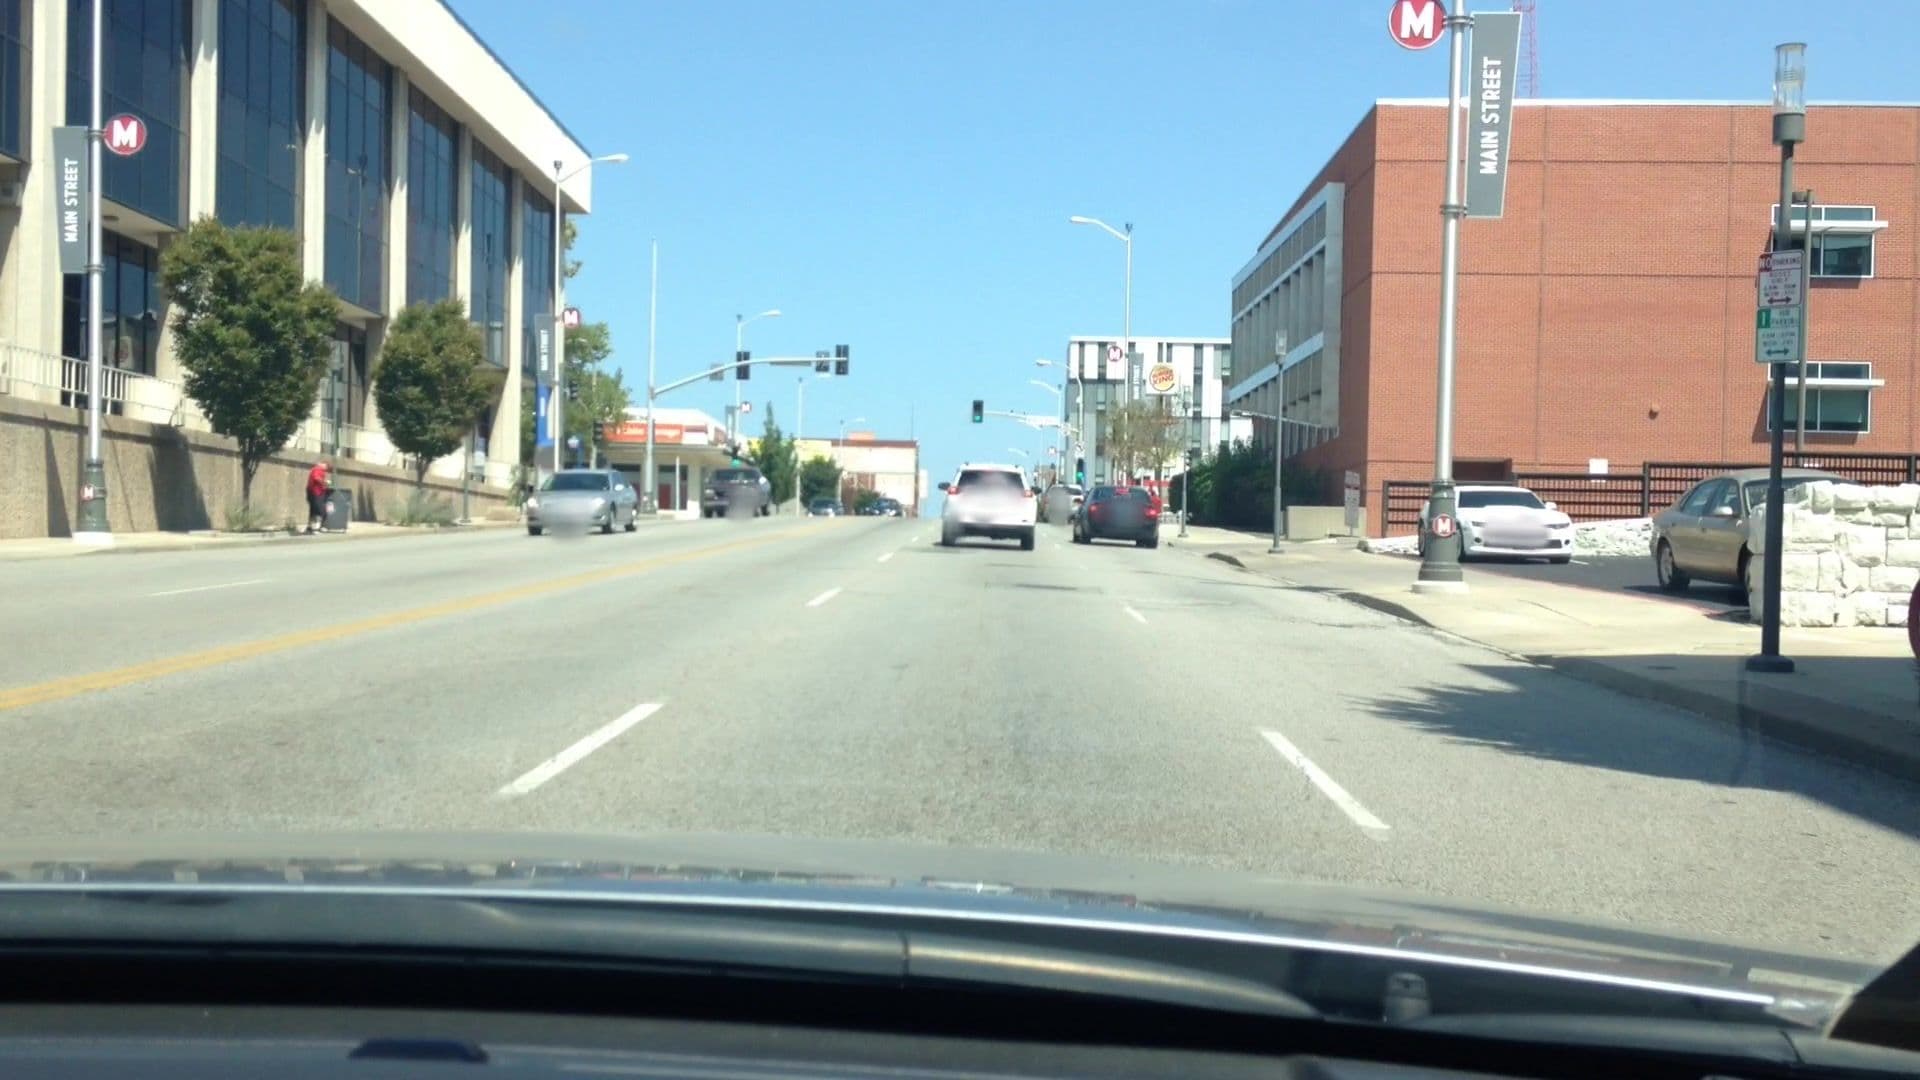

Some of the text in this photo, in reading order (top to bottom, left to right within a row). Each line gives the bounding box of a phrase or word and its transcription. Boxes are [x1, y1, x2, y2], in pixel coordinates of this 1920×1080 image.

[1400, 1, 1434, 39] M
[112, 119, 138, 148] M
[1479, 56, 1502, 174] MAIN STREET
[64, 157, 79, 243] MAIN STREET
